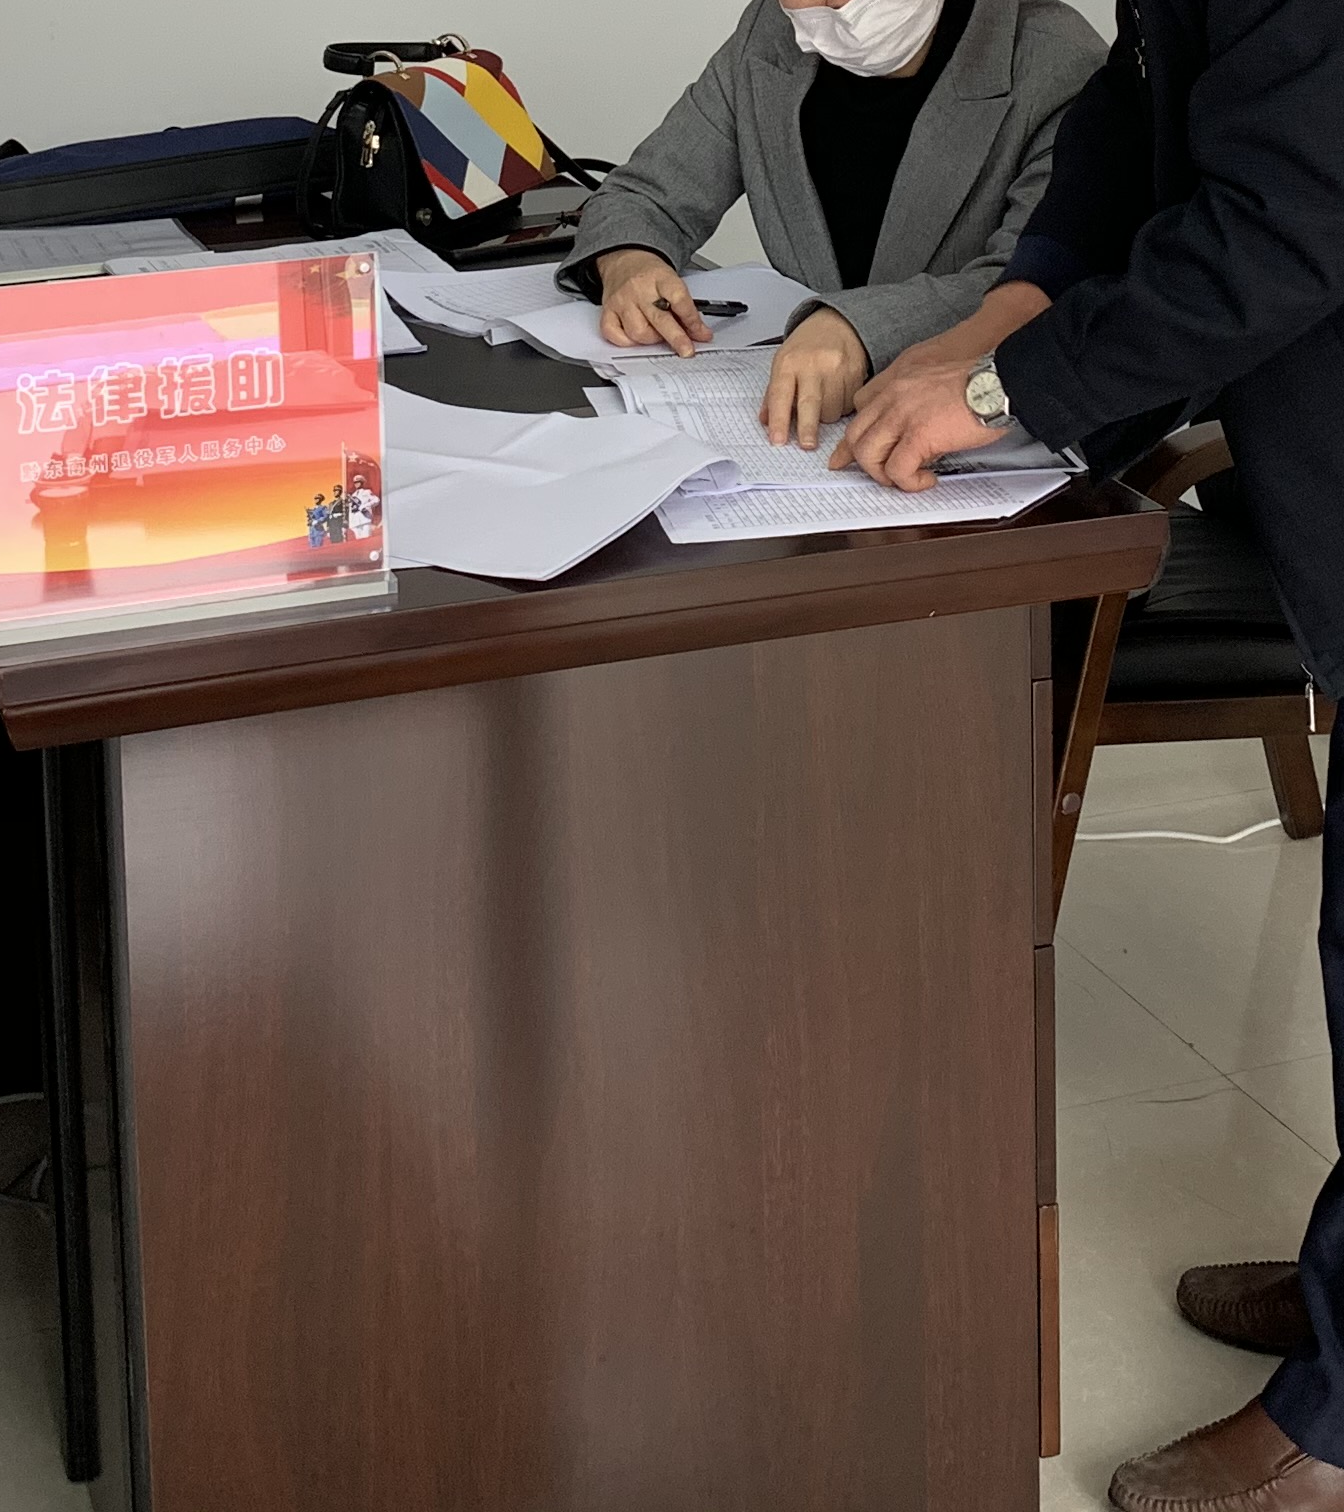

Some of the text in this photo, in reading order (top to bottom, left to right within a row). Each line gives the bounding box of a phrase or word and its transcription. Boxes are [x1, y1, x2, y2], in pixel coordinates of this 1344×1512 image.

[16, 347, 285, 435] 法律援助
[20, 434, 287, 483] 黔东南州退役军人服务中心
